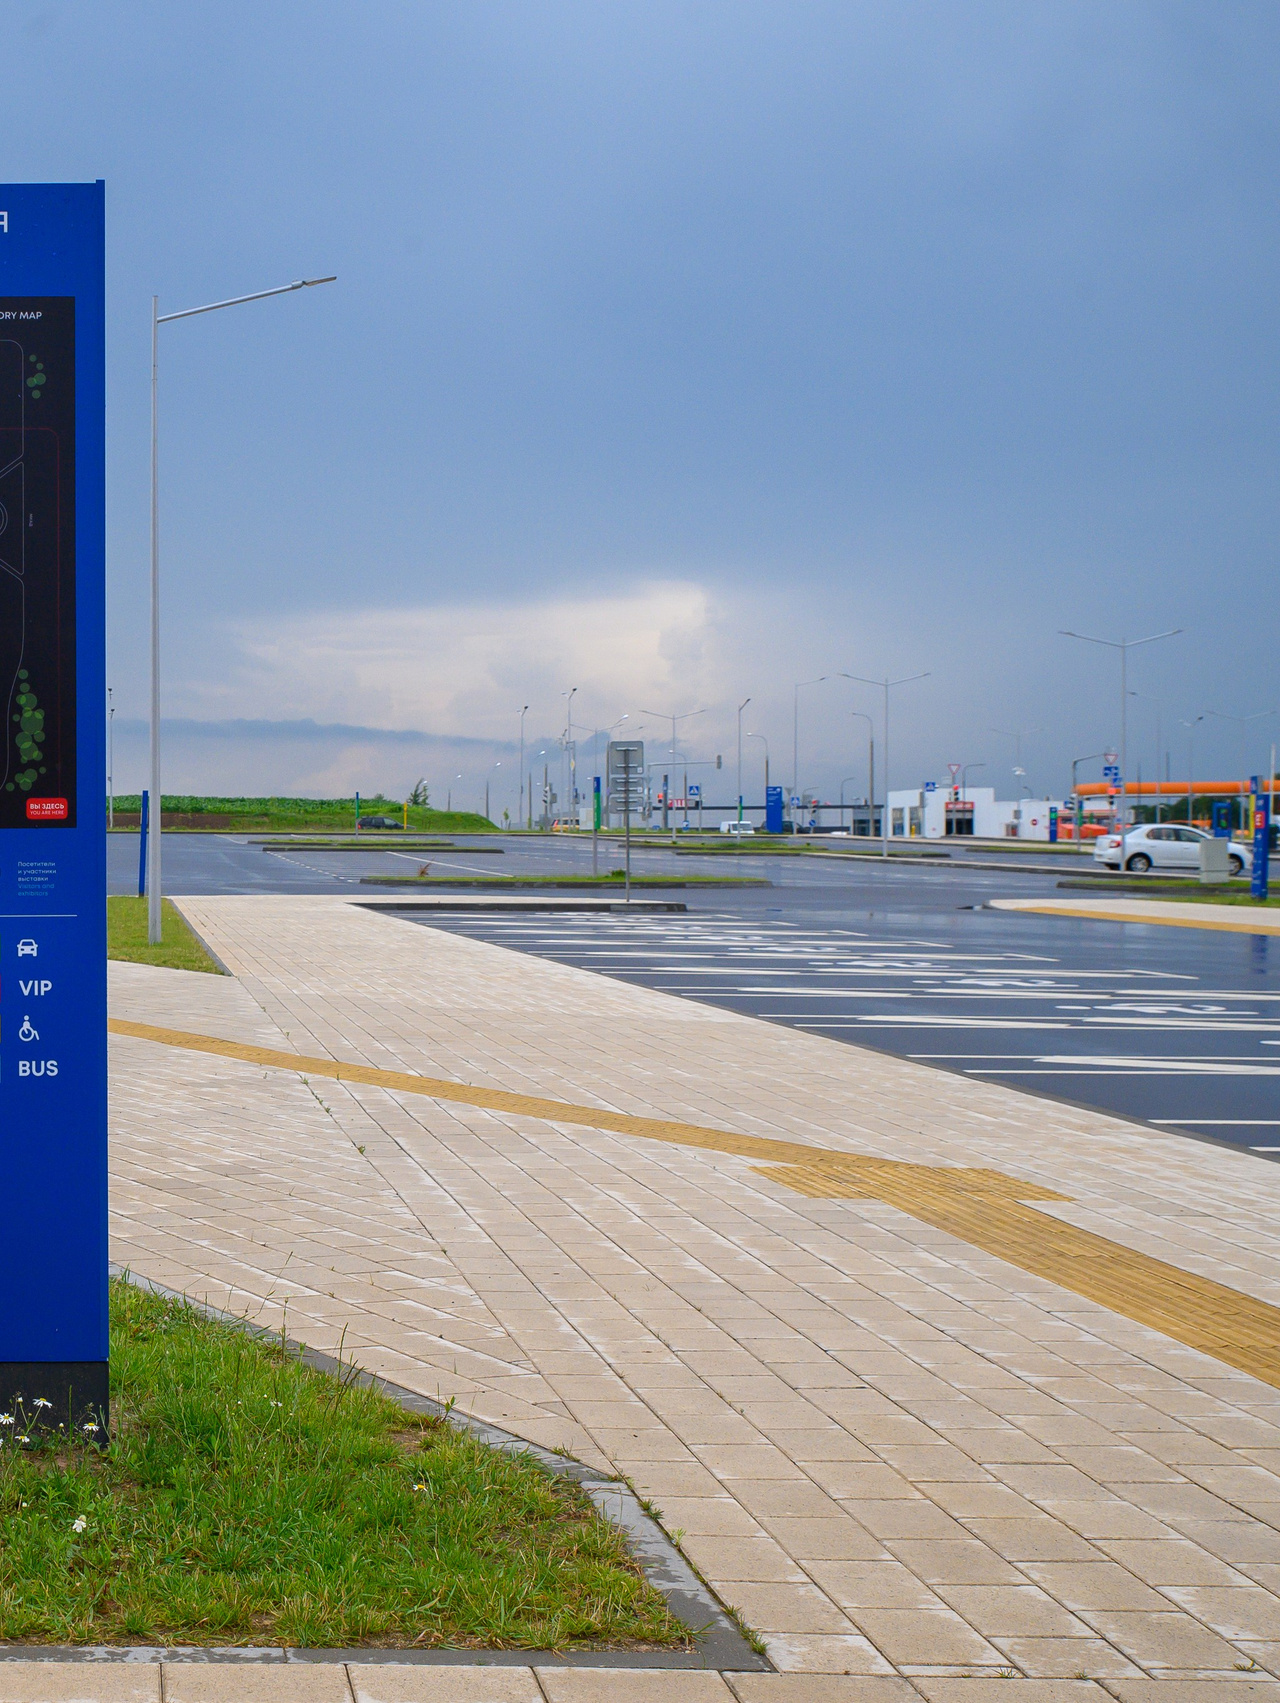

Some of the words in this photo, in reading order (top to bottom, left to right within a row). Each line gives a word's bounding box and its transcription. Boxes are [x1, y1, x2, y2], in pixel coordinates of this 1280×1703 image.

[19, 311, 42, 320] MAP
[19, 980, 53, 996] VIP
[18, 1060, 58, 1077] BUS
